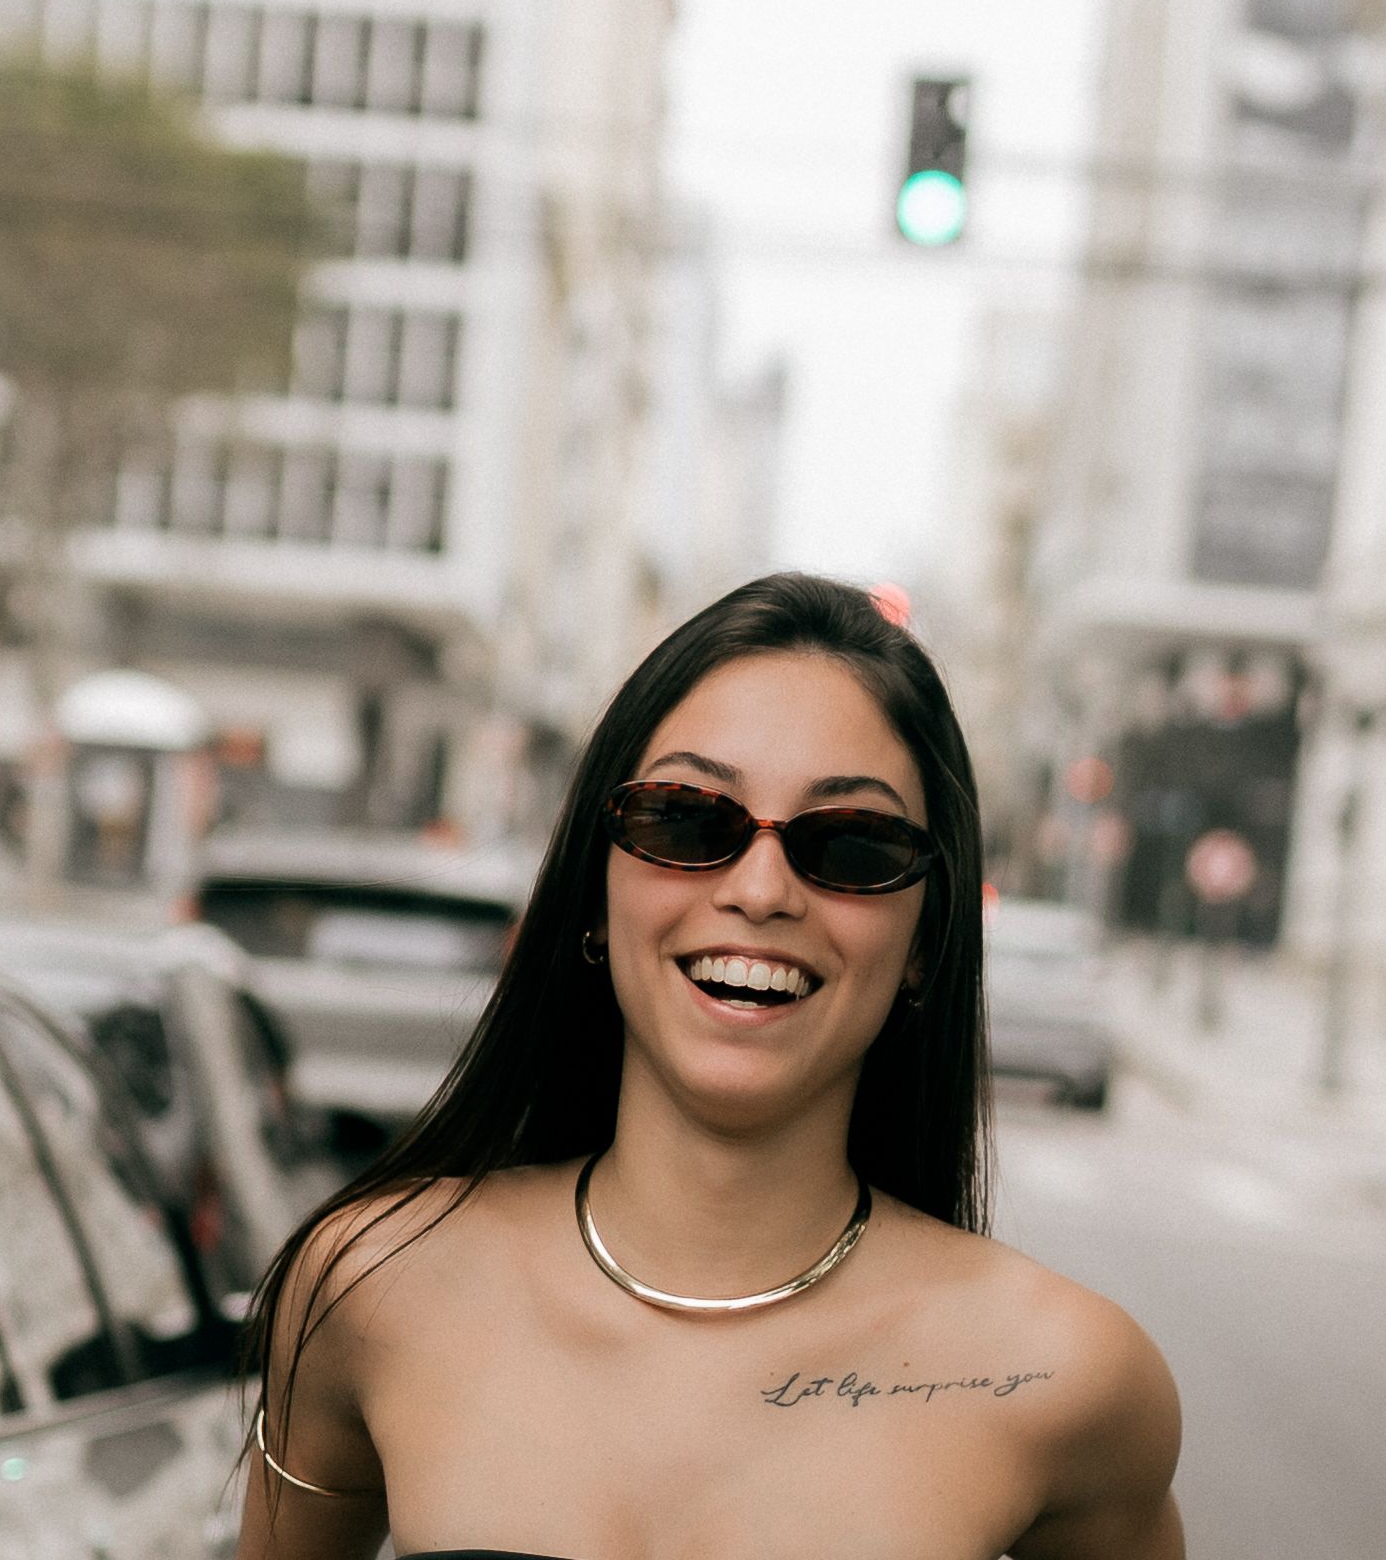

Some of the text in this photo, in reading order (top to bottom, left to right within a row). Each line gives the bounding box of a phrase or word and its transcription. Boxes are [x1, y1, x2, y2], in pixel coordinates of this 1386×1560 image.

[761, 1369, 1056, 1407] Let life surprise you
